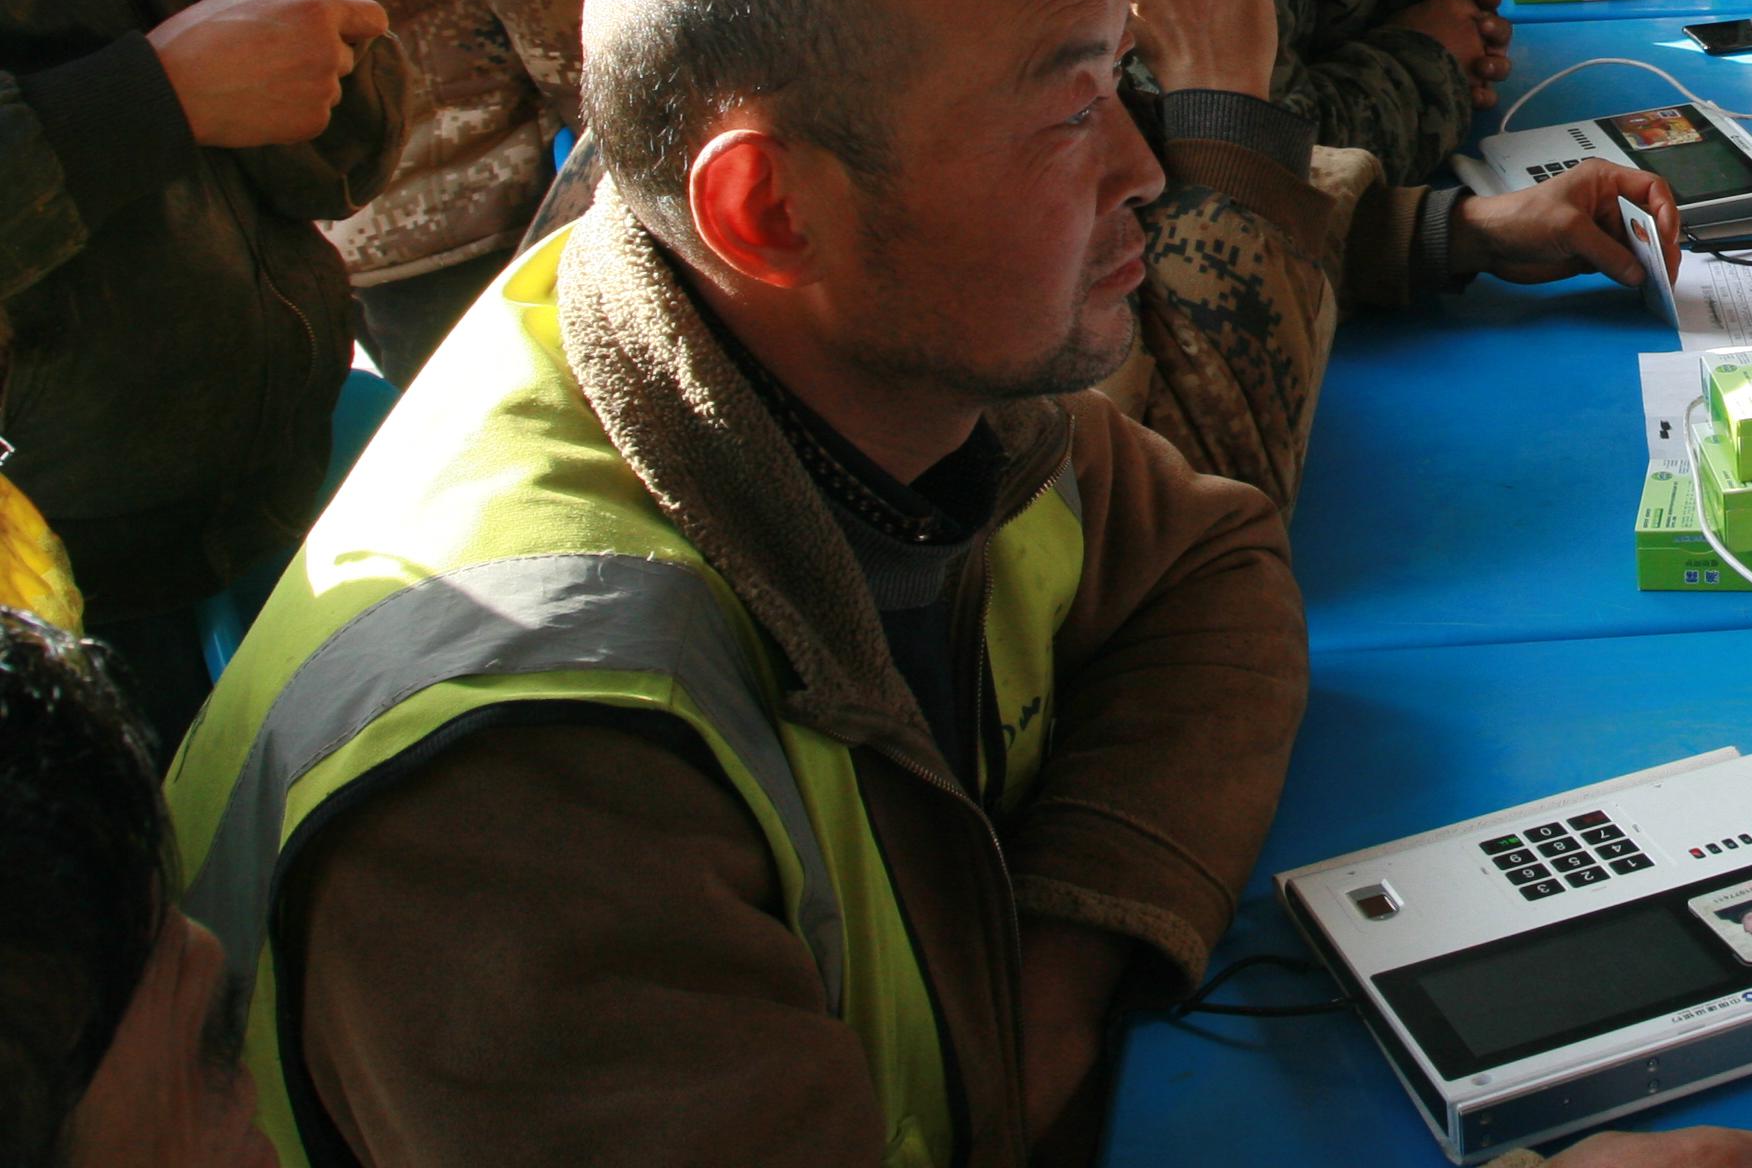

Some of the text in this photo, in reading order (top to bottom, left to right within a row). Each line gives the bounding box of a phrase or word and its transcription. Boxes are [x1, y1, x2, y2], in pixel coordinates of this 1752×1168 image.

[1684, 570, 1720, 584] 滴露
[1509, 830, 1611, 863] 7 8 9
[1539, 827, 1552, 836] 0
[1522, 844, 1622, 878] 4 5 6
[1537, 859, 1637, 894] 1 2 3
